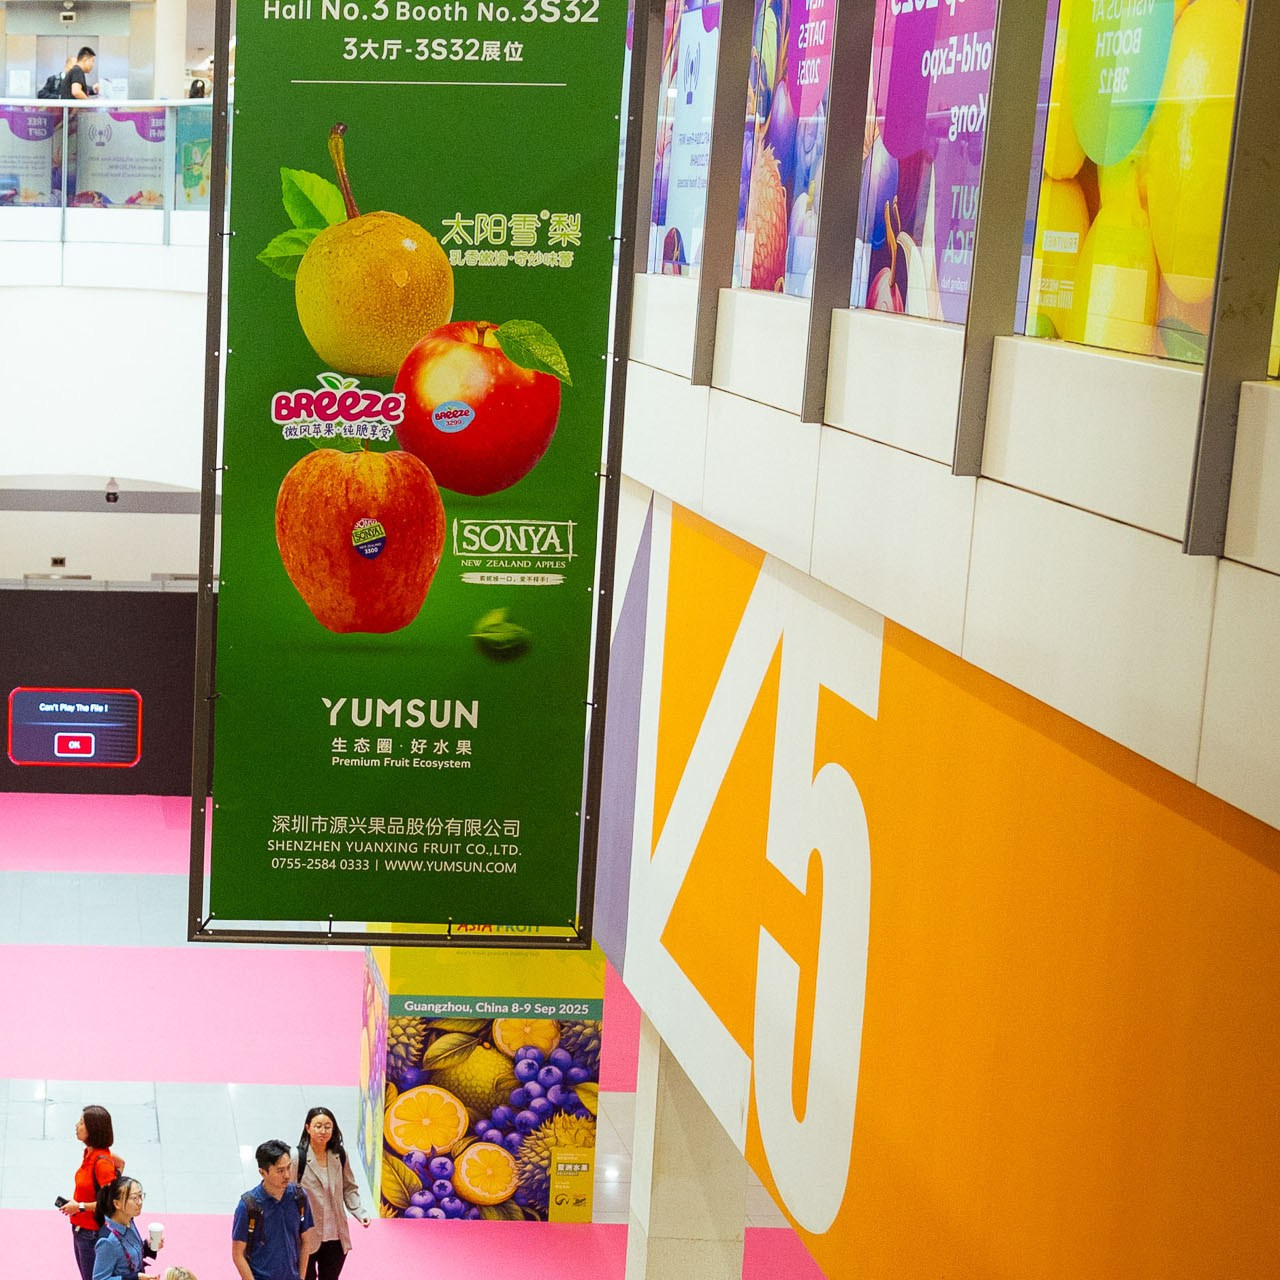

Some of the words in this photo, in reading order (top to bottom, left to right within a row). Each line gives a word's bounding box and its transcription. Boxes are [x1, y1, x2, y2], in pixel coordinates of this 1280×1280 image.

[263, 0, 312, 20] Hall
[395, 0, 468, 22] Booth
[342, 37, 524, 62] 3大厅-3S32展位
[463, 525, 564, 554] SONYA
[486, 560, 531, 568] ZEALAND
[535, 561, 566, 569] APPLES
[39, 702, 58, 713] Can't
[60, 702, 75, 714] Play
[76, 703, 89, 712] The
[90, 703, 103, 713] File
[321, 697, 479, 729] YUMSUN
[332, 756, 381, 767] Premium
[384, 757, 410, 768] Fruit
[413, 758, 471, 769] Ecosystem
[272, 814, 521, 838] 深圳市源兴果品股份有限公司
[267, 839, 341, 852] SHENZHEN
[345, 840, 419, 854] YUANXING
[423, 842, 462, 855] FRUIT
[465, 843, 522, 857] CO.,LTD.
[271, 857, 337, 870] 0755-2584
[339, 858, 370, 871] 0333
[384, 860, 517, 874] WWW.YUMSUN.COM
[753, 565, 885, 1234] 5
[404, 1001, 473, 1013] Guangzhou,
[476, 1002, 508, 1013] China
[511, 1003, 531, 1013] 8-9
[534, 1004, 556, 1015] Sep
[558, 1004, 589, 1014] 2025
